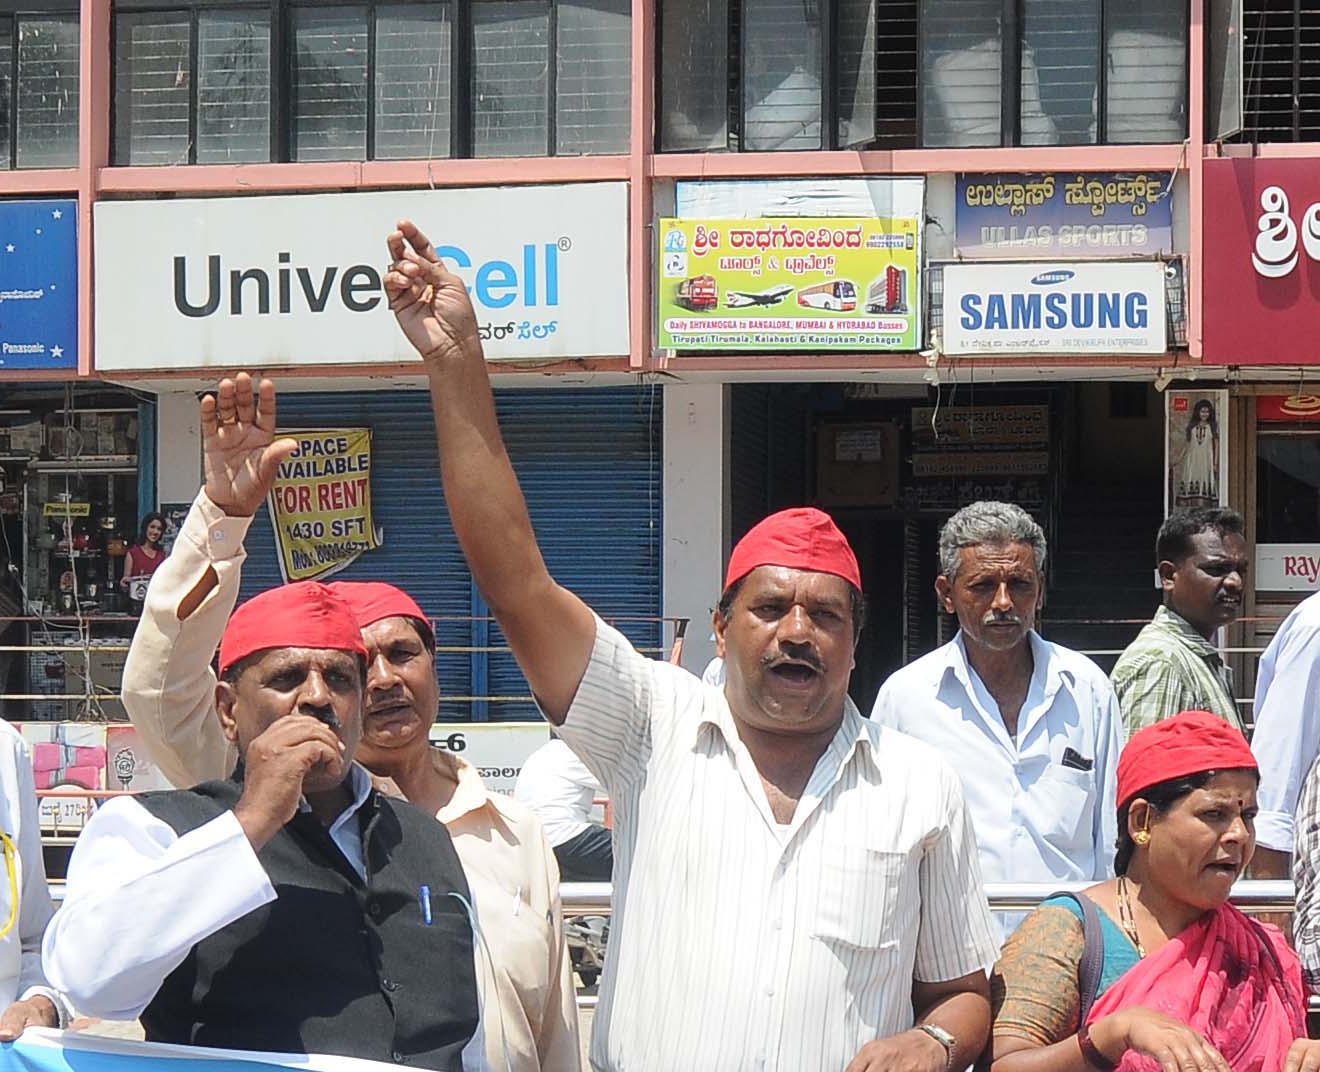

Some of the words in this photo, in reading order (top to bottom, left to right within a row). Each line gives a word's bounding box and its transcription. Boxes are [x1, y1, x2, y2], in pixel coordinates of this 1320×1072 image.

[966, 176, 1055, 216] ಉಲ್ಲಾಸ್
[692, 225, 719, 255] ಶ್ರೀ
[981, 225, 1053, 247] ULLAS
[1058, 224, 1149, 246] SPORTS
[768, 257, 779, 270] &
[1036, 273, 1069, 282] SAMSUNG
[960, 292, 1148, 330] SAMSUNG
[670, 321, 687, 331] Daily
[795, 320, 826, 329] MUMBAI
[3, 342, 45, 353] Panasonic
[275, 485, 312, 514] FOR
[318, 479, 368, 512] RENT
[287, 522, 324, 541] 1430
[331, 517, 365, 537] SFT
